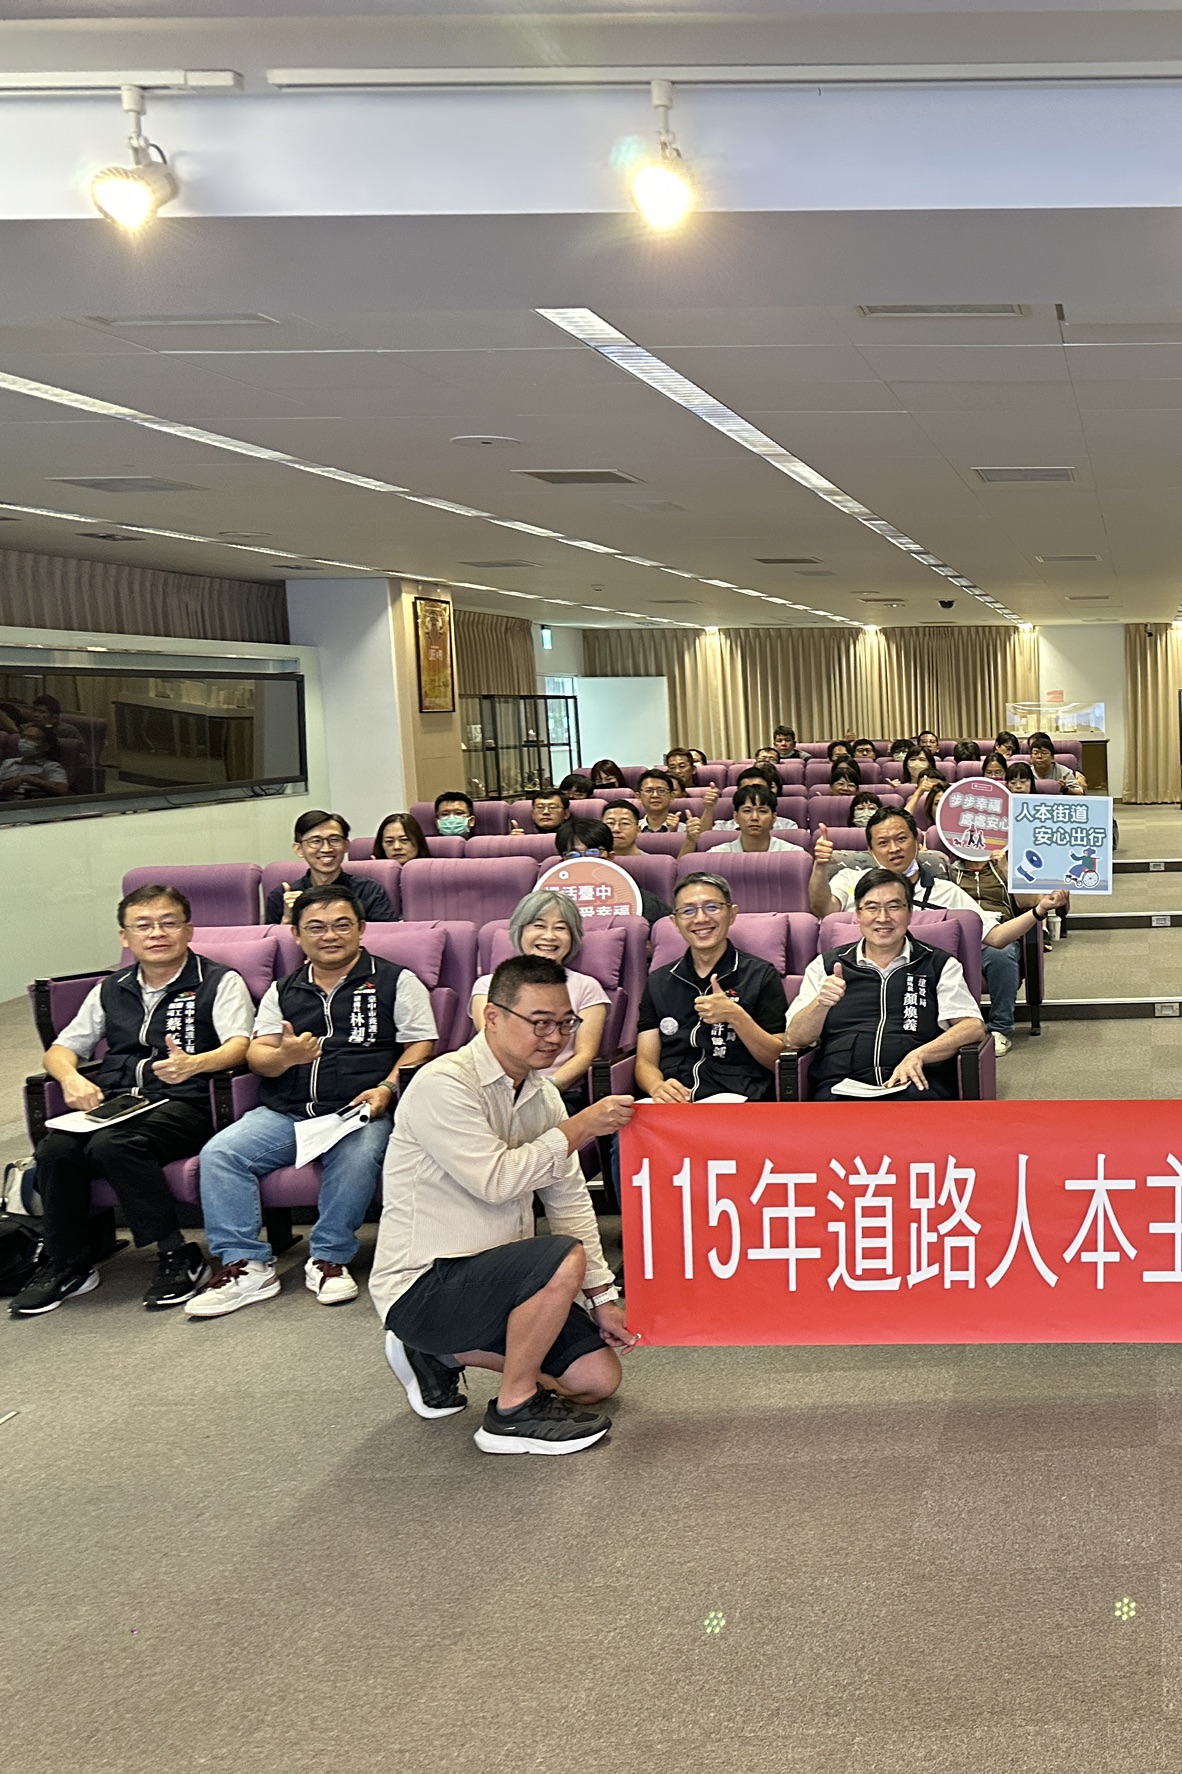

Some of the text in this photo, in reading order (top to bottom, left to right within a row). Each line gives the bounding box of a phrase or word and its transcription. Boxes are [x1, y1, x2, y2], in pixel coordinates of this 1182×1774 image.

[950, 793, 1002, 813] 步步幸福
[1016, 803, 1088, 823] 人本街道
[1034, 827, 1107, 847] 安心出行
[578, 904, 631, 917] 受幸福
